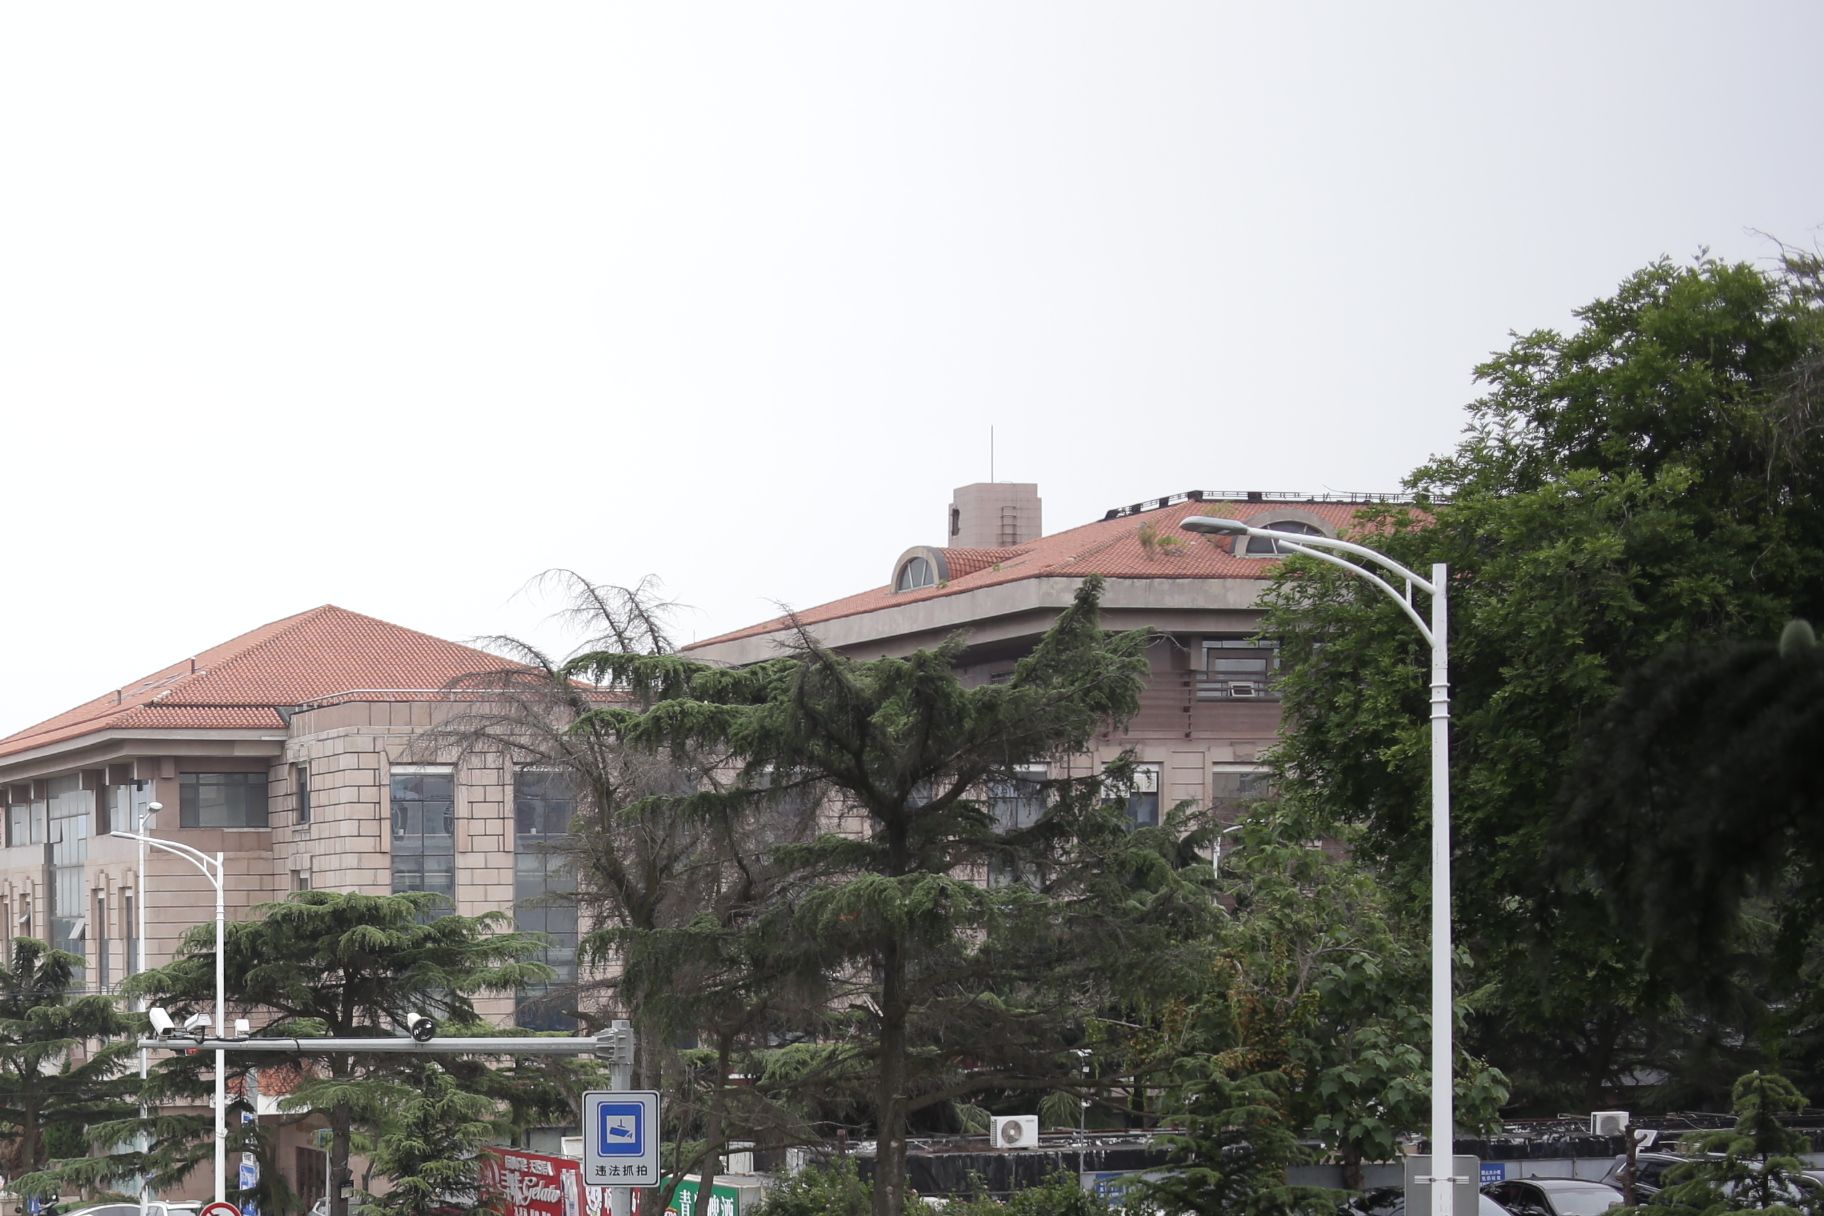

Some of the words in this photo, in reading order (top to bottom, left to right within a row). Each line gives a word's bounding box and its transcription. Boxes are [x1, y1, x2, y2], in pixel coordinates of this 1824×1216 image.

[595, 1164, 648, 1177] 违法抓拍
[522, 1176, 561, 1206] Gelato
